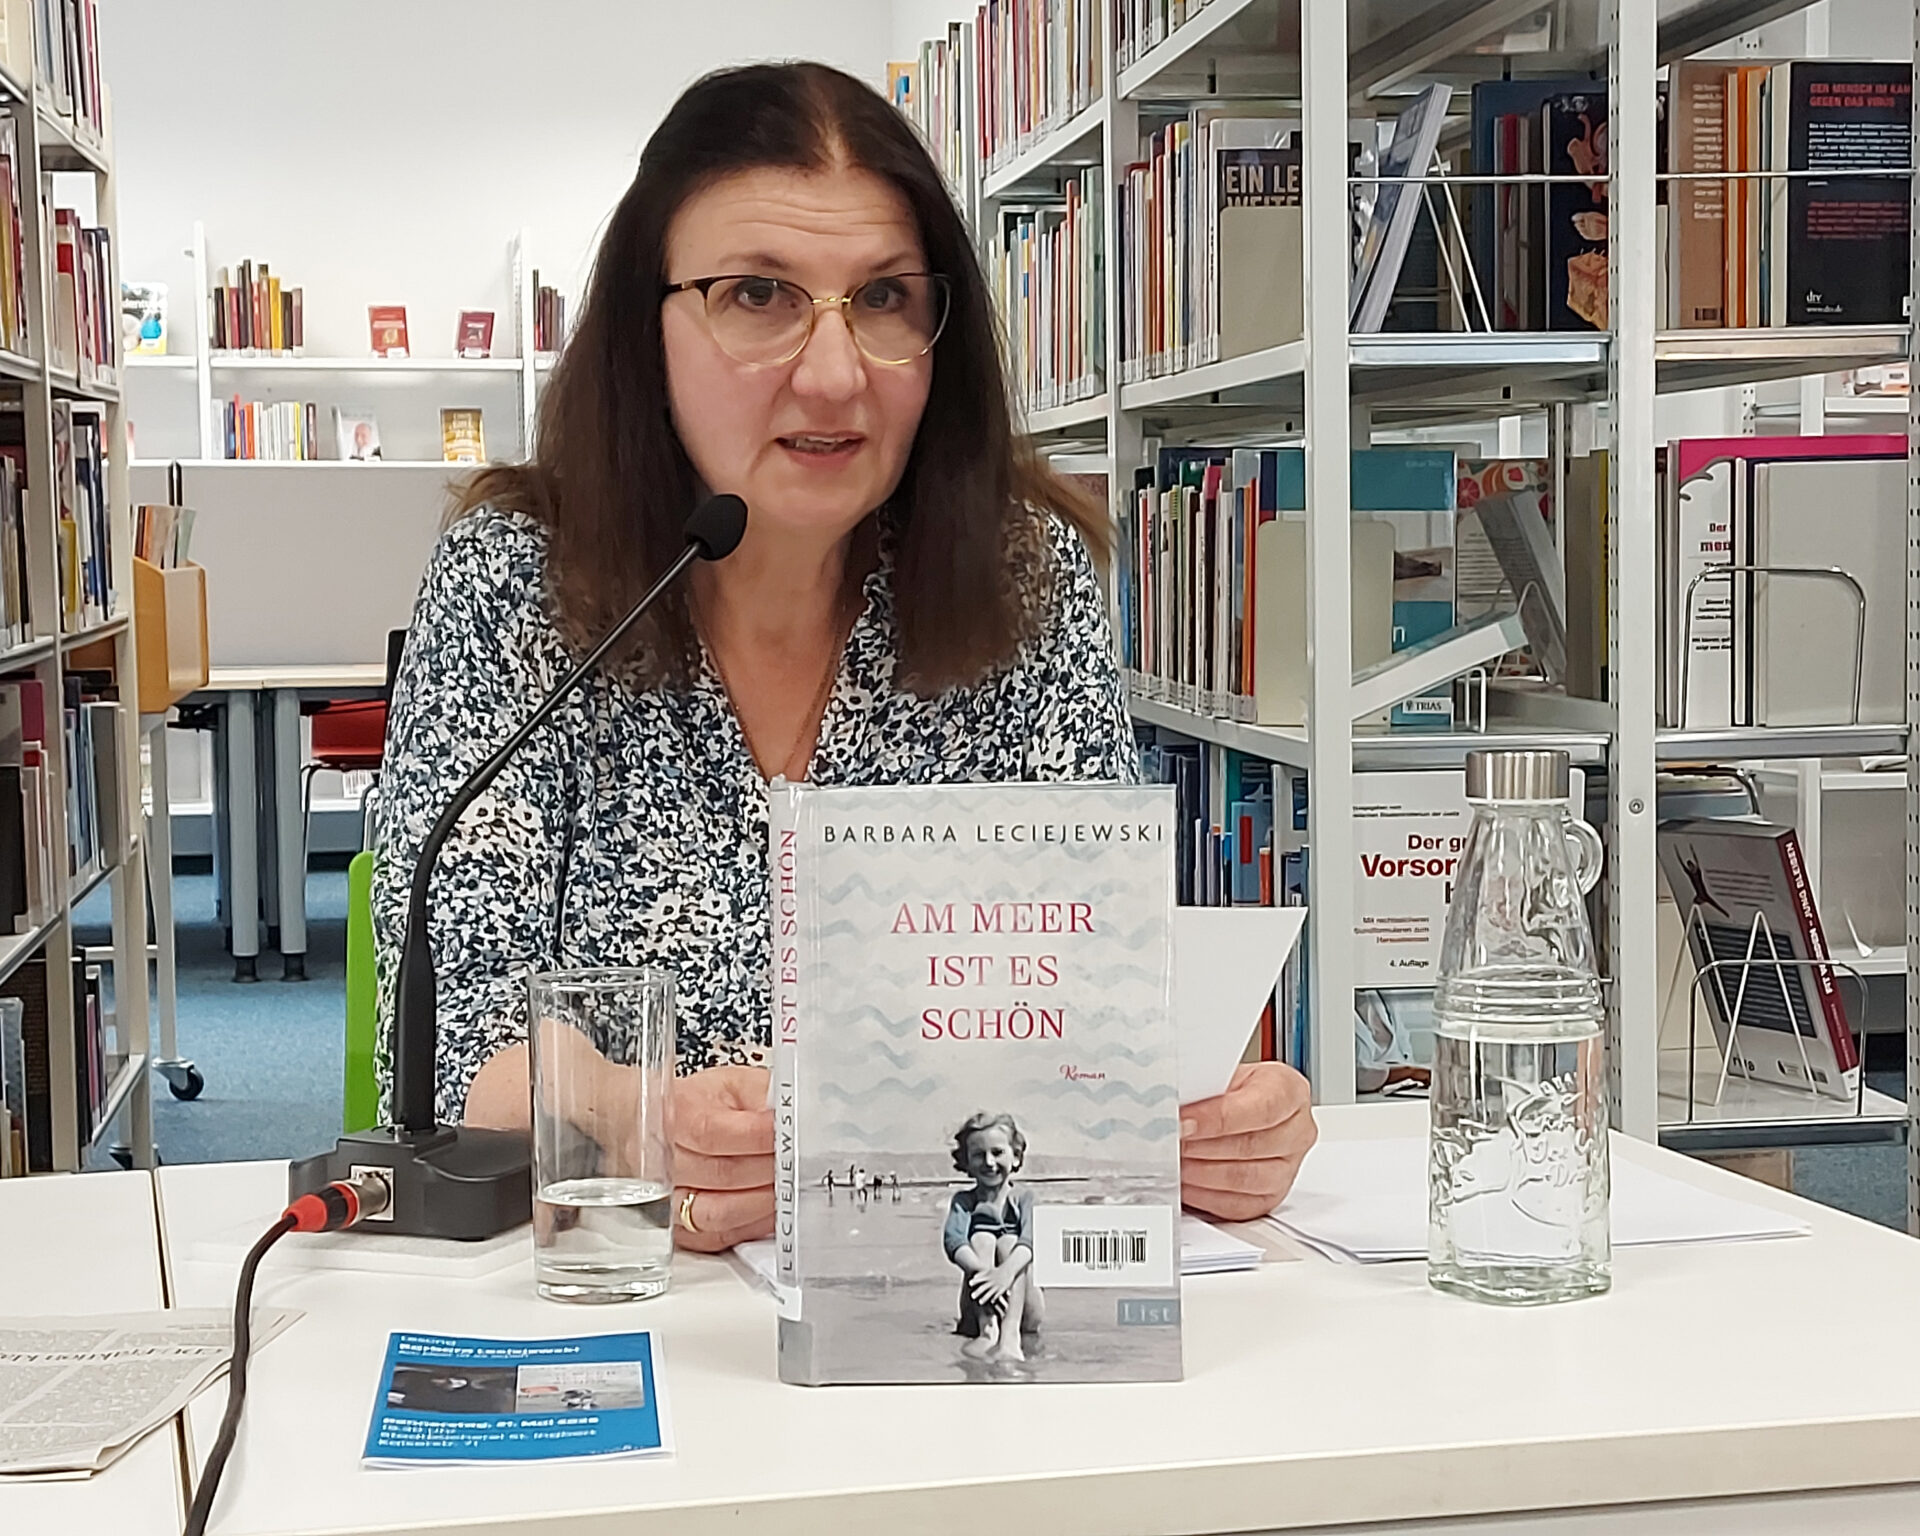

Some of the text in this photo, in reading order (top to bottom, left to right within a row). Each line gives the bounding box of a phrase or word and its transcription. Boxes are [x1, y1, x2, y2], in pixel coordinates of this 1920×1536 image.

[1226, 165, 1264, 193] EIN
[1416, 701, 1442, 711] TRIAS
[824, 824, 1163, 845] BARBARA LECIEJEWSKI
[1408, 834, 1444, 850] Der
[1360, 853, 1461, 877] Vorsor
[891, 901, 1096, 934] AM MEER
[778, 830, 798, 1045] IST ES SCHÖN
[927, 955, 1060, 987] IST ES
[920, 1001, 1066, 1040] SCHÖN
[1059, 1064, 1105, 1081] Roman
[781, 1082, 793, 1272] LECIEJEWSKI
[1123, 1303, 1171, 1322] List
